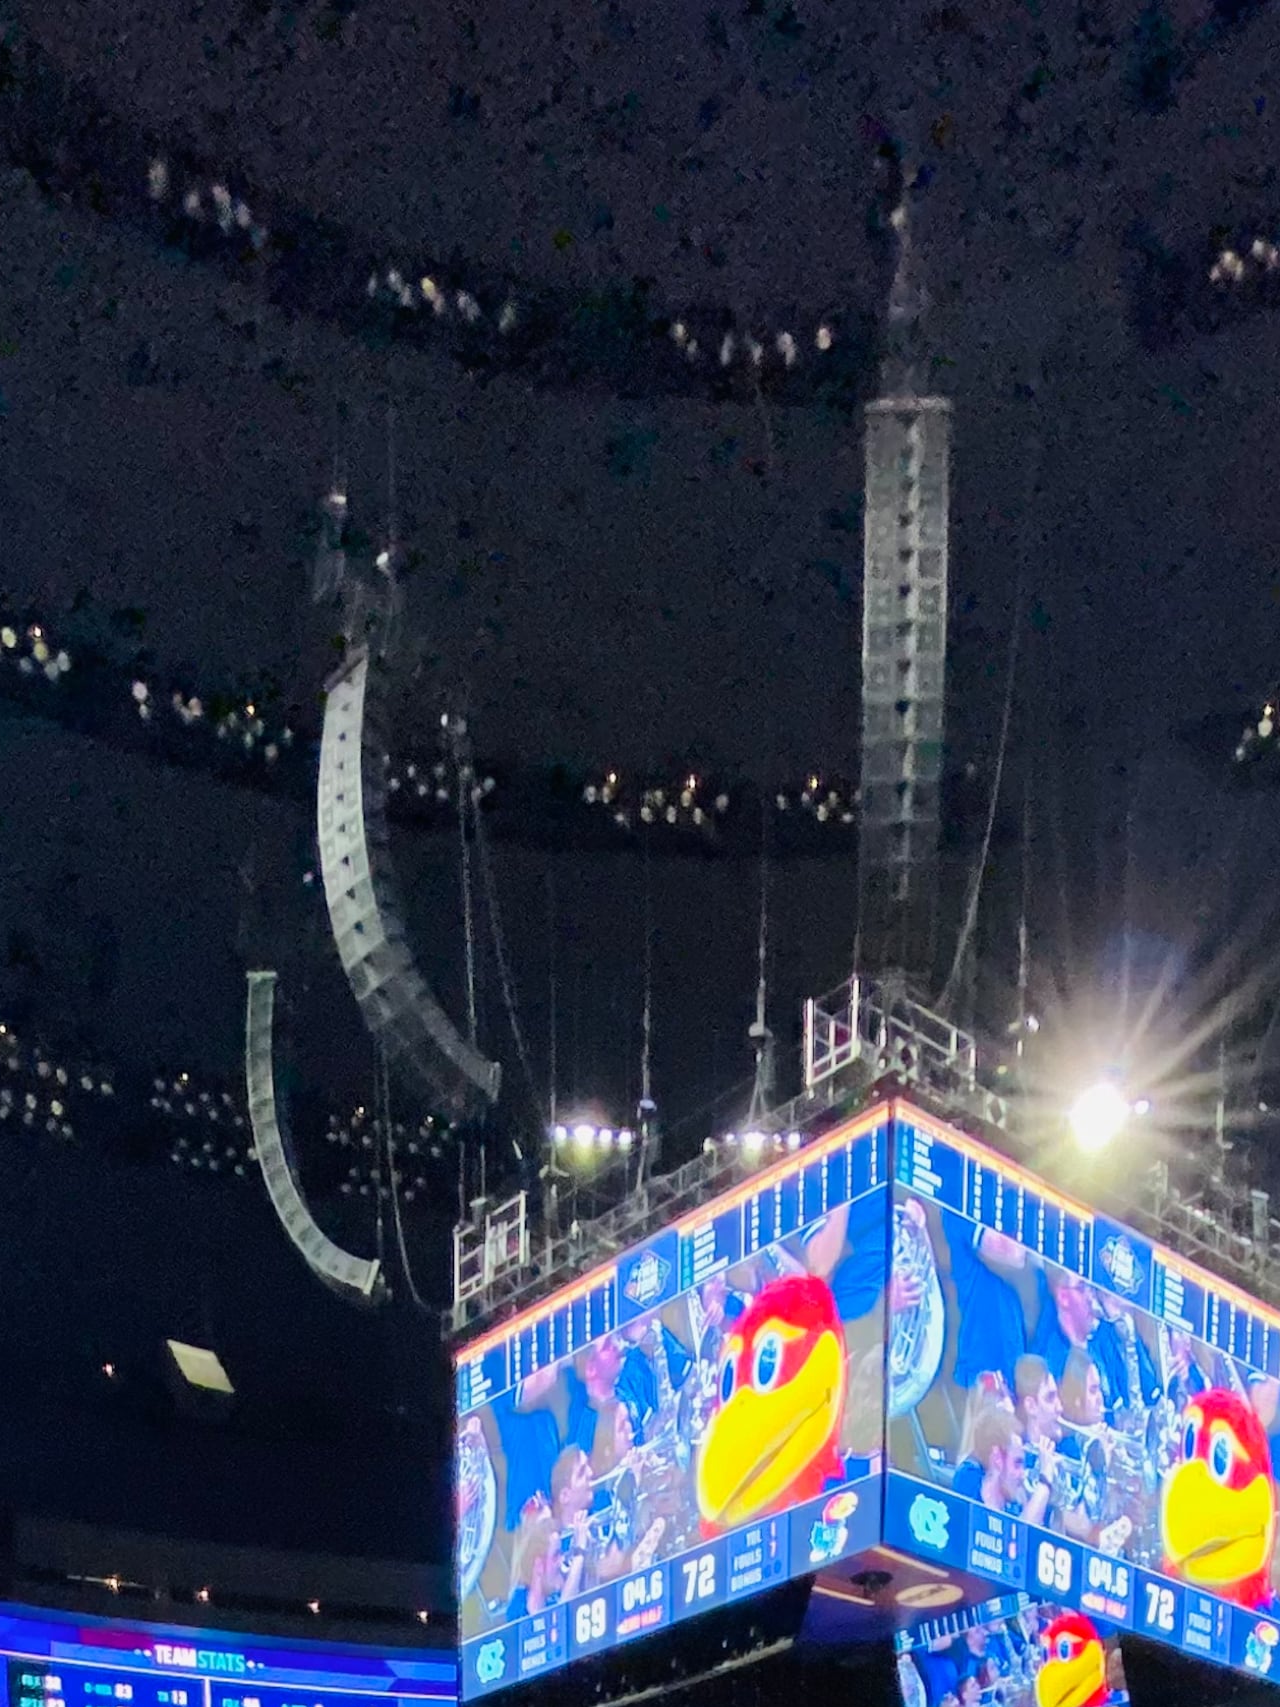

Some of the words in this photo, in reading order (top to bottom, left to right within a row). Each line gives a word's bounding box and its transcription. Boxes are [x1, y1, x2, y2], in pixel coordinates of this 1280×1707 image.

[975, 1531, 1004, 1556] FOULS
[733, 1548, 763, 1572] FOULS
[576, 1598, 607, 1644] 69
[623, 1567, 664, 1612] 04.6
[682, 1553, 716, 1605] 72
[1037, 1540, 1073, 1592] 69
[1088, 1556, 1129, 1599] 04.6
[1146, 1582, 1176, 1633] 72
[154, 1644, 197, 1668] TEAM
[198, 1650, 246, 1673] STATS
